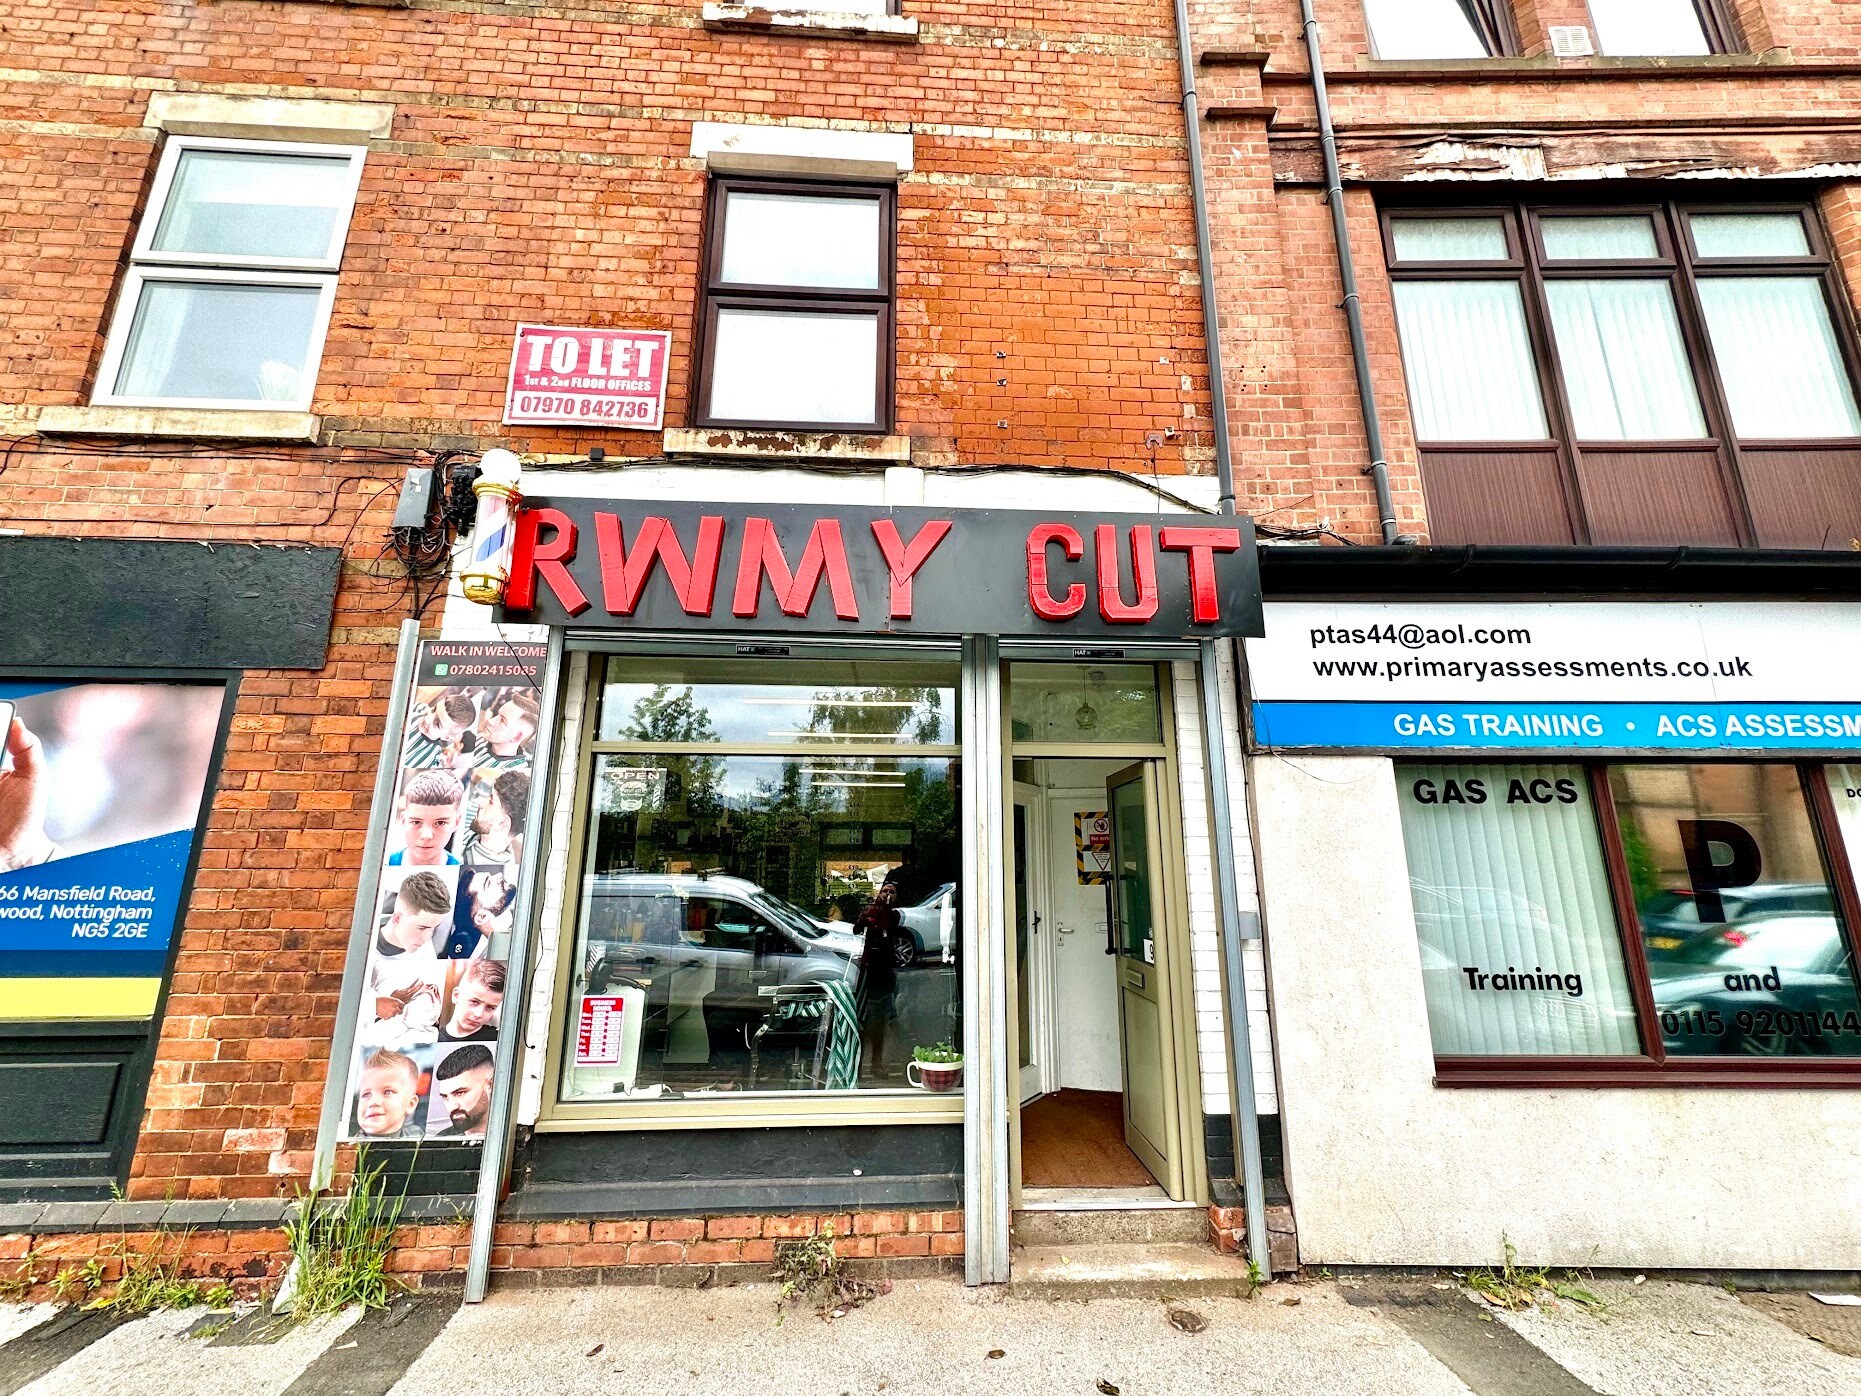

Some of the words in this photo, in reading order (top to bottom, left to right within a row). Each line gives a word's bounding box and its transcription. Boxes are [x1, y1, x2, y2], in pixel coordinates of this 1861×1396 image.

[527, 336, 580, 374] TO
[588, 338, 659, 378] LET
[524, 375, 539, 386] 1st
[541, 378, 549, 386] &
[551, 376, 570, 387] 2nd
[571, 377, 607, 390] FLOOR
[607, 380, 652, 391] OFFICES
[520, 396, 576, 415] 07970
[579, 399, 648, 419] 842736
[505, 508, 953, 622] RWMY
[1026, 523, 1241, 624] CUT
[1309, 624, 1532, 649] ptas44@aol.com
[431, 645, 467, 656] WALK
[469, 646, 483, 656] IN
[486, 646, 547, 657] WELCOME
[1312, 657, 1753, 683] www.primaryassessments.co.uk
[1394, 714, 1455, 737] GAS
[1462, 714, 1604, 738] TRAINING
[1656, 714, 1717, 738] ACS
[611, 772, 660, 780] OPEN
[1413, 779, 1488, 805] GAS
[1506, 779, 1579, 805] ACS
[1677, 819, 1762, 923] P
[23, 886, 105, 901] Mansfield
[109, 886, 156, 902] Road,
[50, 904, 153, 922] Nottingham
[71, 922, 109, 938] NG5
[112, 923, 149, 938] 2GE
[1463, 966, 1584, 997] Training
[1724, 966, 1783, 992] and
[1661, 1010, 1726, 1036] 0115
[1735, 1010, 1861, 1036] 9201144
